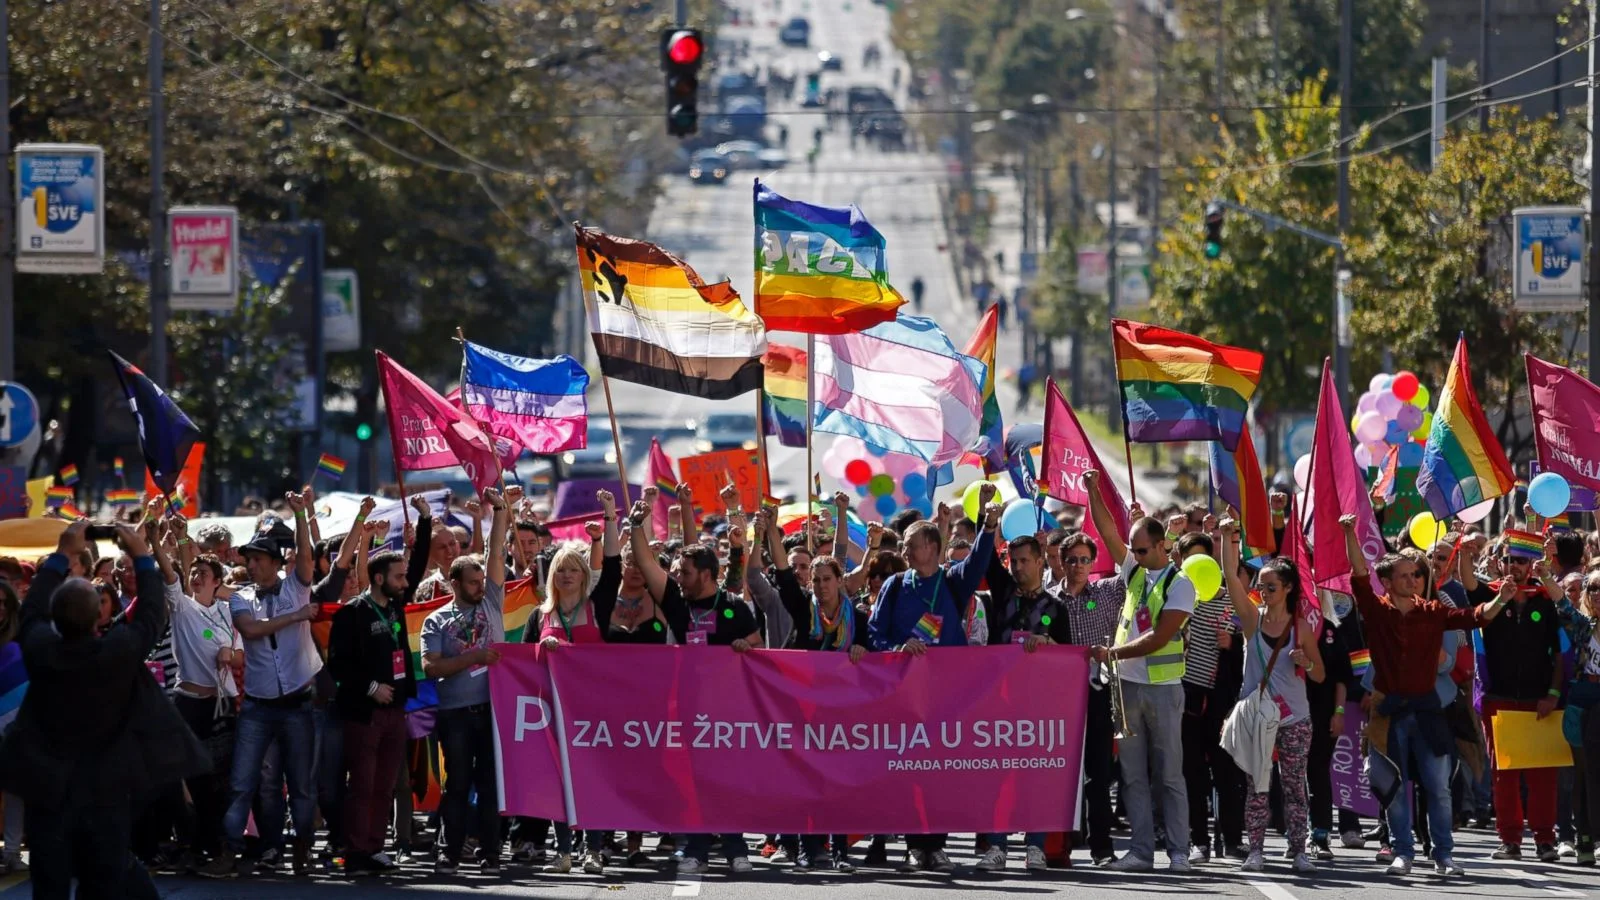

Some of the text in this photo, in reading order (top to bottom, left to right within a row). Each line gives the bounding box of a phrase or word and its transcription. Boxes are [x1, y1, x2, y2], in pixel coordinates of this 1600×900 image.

[48, 206, 79, 221] SVE
[1544, 256, 1568, 269] SVE
[1063, 447, 1091, 469] Pra
[1060, 471, 1089, 493] NO
[571, 713, 1065, 755] ZA SVE ŽRTVE NASILJA U SRBIJI
[888, 757, 1066, 771] PARADA PONOSA BEOGRAD
[1332, 735, 1354, 774] ROD
